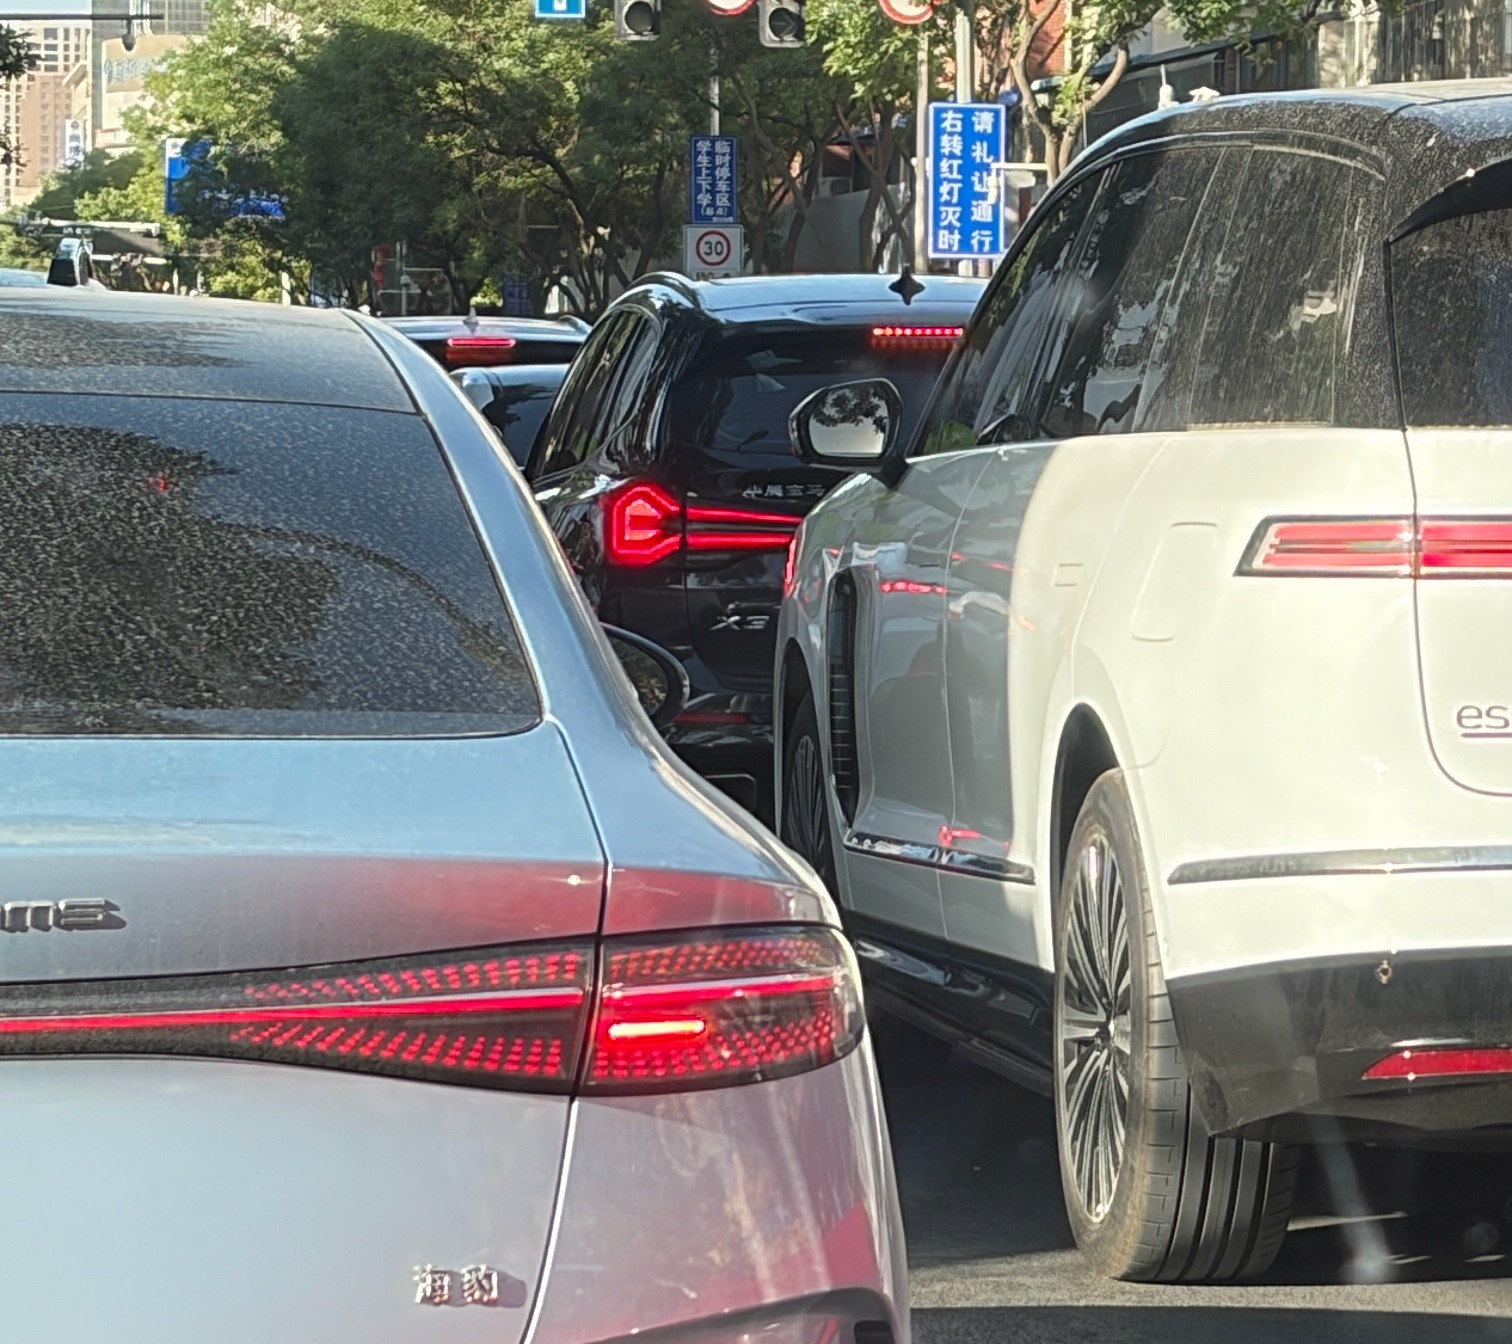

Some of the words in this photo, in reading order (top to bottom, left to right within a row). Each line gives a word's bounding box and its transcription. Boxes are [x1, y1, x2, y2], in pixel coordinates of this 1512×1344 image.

[696, 140, 712, 206] 学生上下学
[714, 140, 732, 206] 临时停车区
[938, 110, 964, 252] 右转红灯灭时
[970, 111, 994, 252] 请礼让通行
[703, 241, 724, 256] 30
[413, 1264, 498, 1304] 海豹
